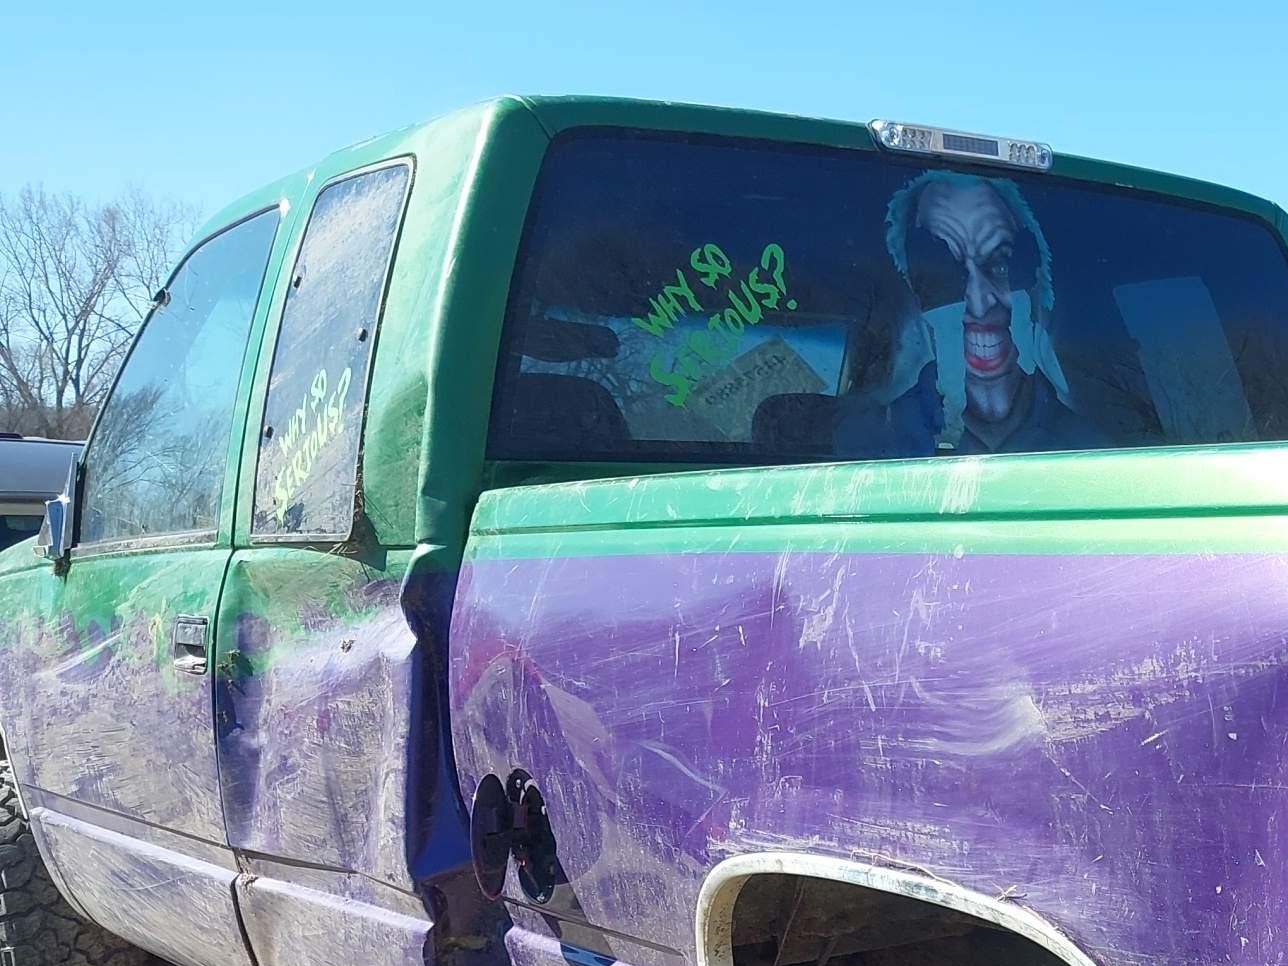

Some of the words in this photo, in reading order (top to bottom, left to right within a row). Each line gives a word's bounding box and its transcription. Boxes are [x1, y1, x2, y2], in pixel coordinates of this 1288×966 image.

[632, 268, 704, 337] WHY
[690, 243, 732, 290] SO
[275, 368, 351, 526] SERIOUS?
[279, 392, 307, 457] WHY
[311, 368, 328, 412] SO
